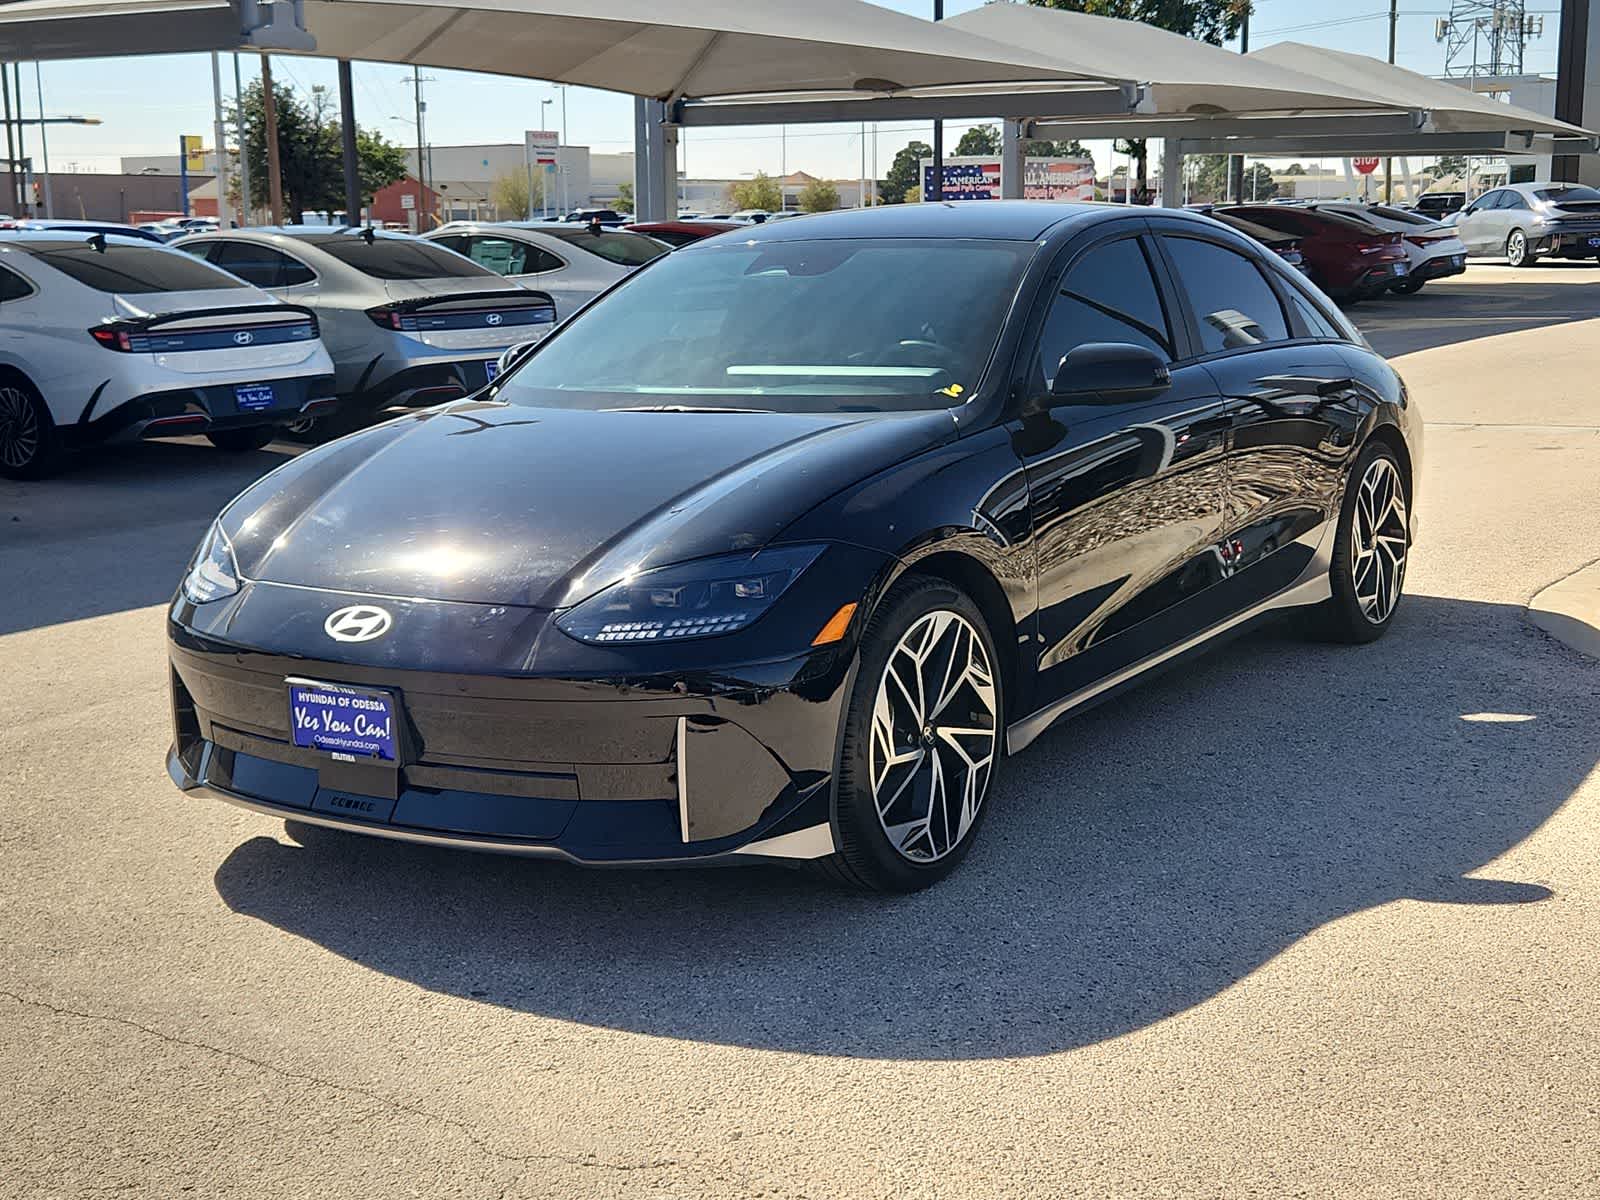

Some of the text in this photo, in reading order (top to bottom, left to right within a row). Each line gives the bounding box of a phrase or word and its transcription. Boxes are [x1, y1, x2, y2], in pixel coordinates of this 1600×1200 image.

[1354, 156, 1377, 166] STOP
[298, 692, 387, 712] HYUNDAI OF ODESSA
[294, 706, 391, 740] Yes You Can!
[314, 734, 380, 751] OdessaHyundai.com
